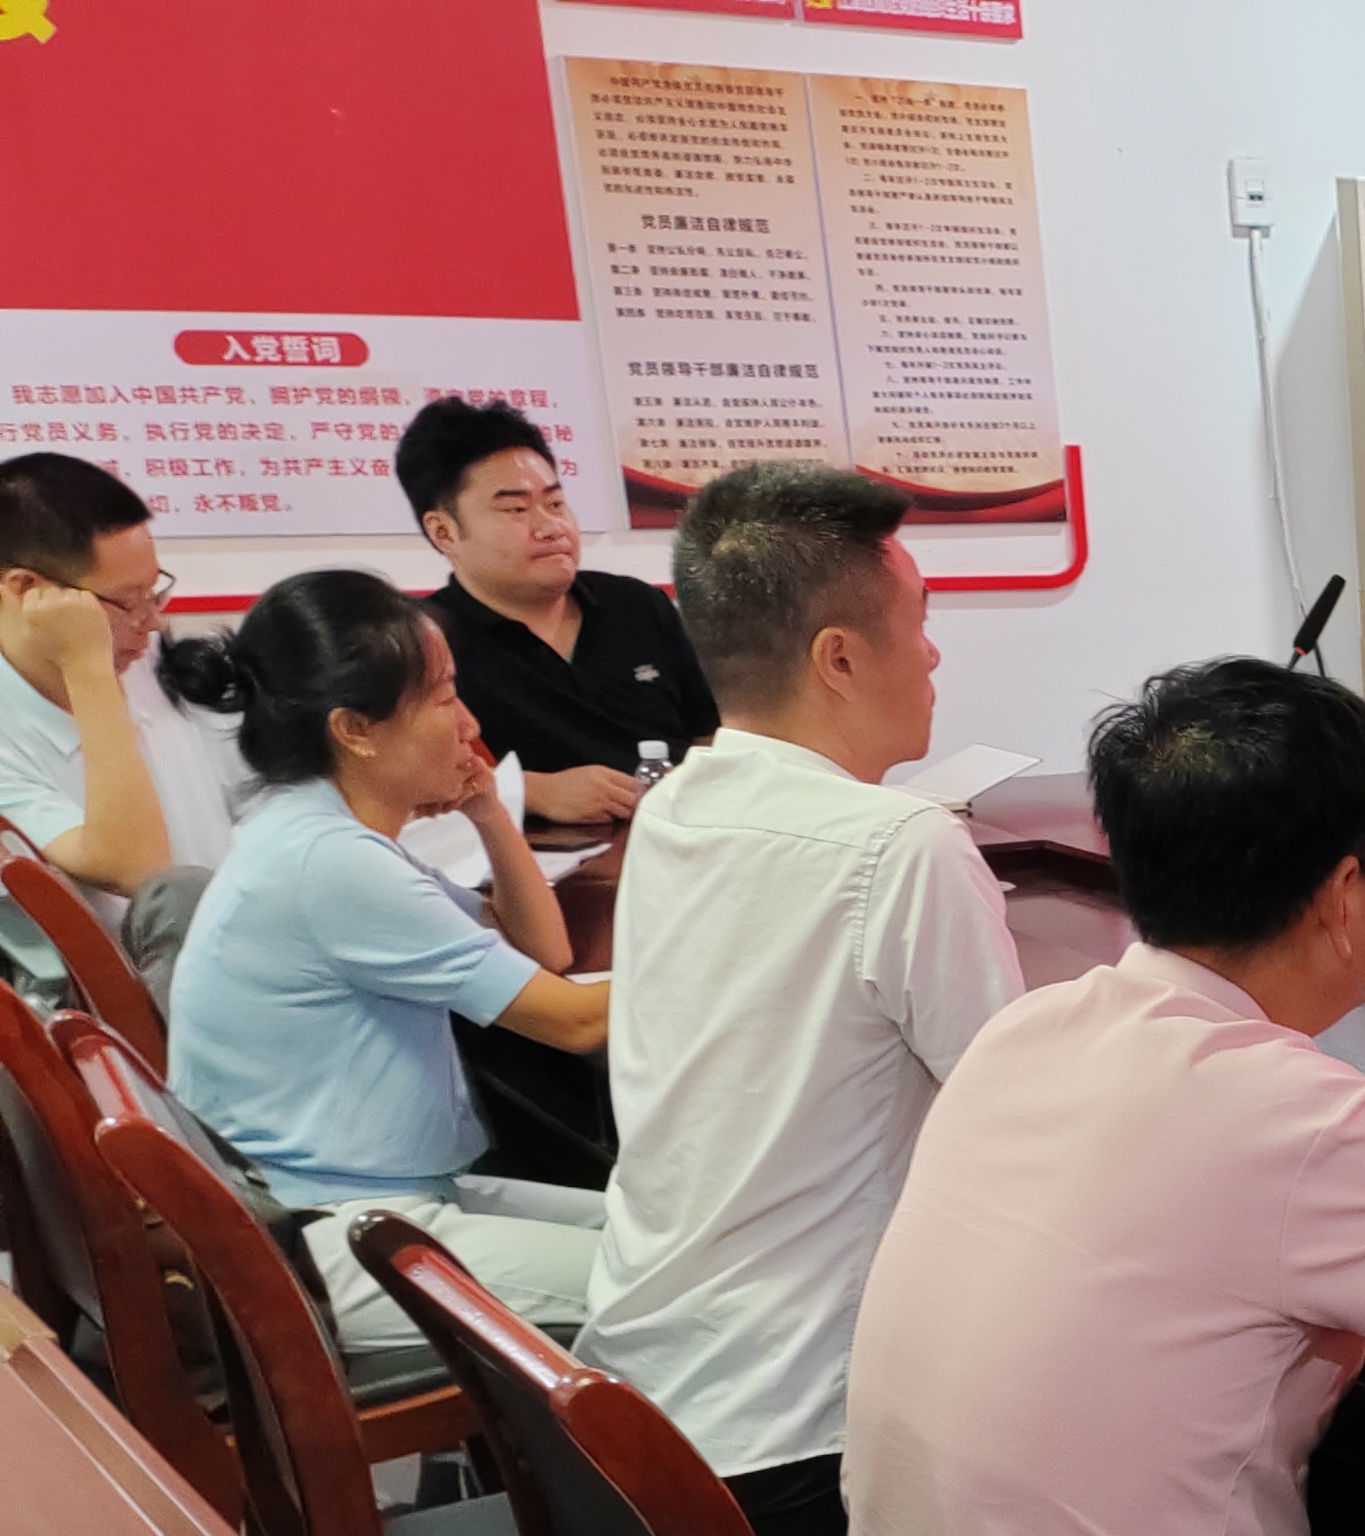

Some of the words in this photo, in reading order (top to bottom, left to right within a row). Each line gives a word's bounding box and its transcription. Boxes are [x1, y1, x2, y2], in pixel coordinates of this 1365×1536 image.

[641, 214, 771, 234] 党员廉洁自律规范
[222, 334, 342, 364] 入党誓词
[627, 361, 820, 379] 党员领导干部廉洁自律规范
